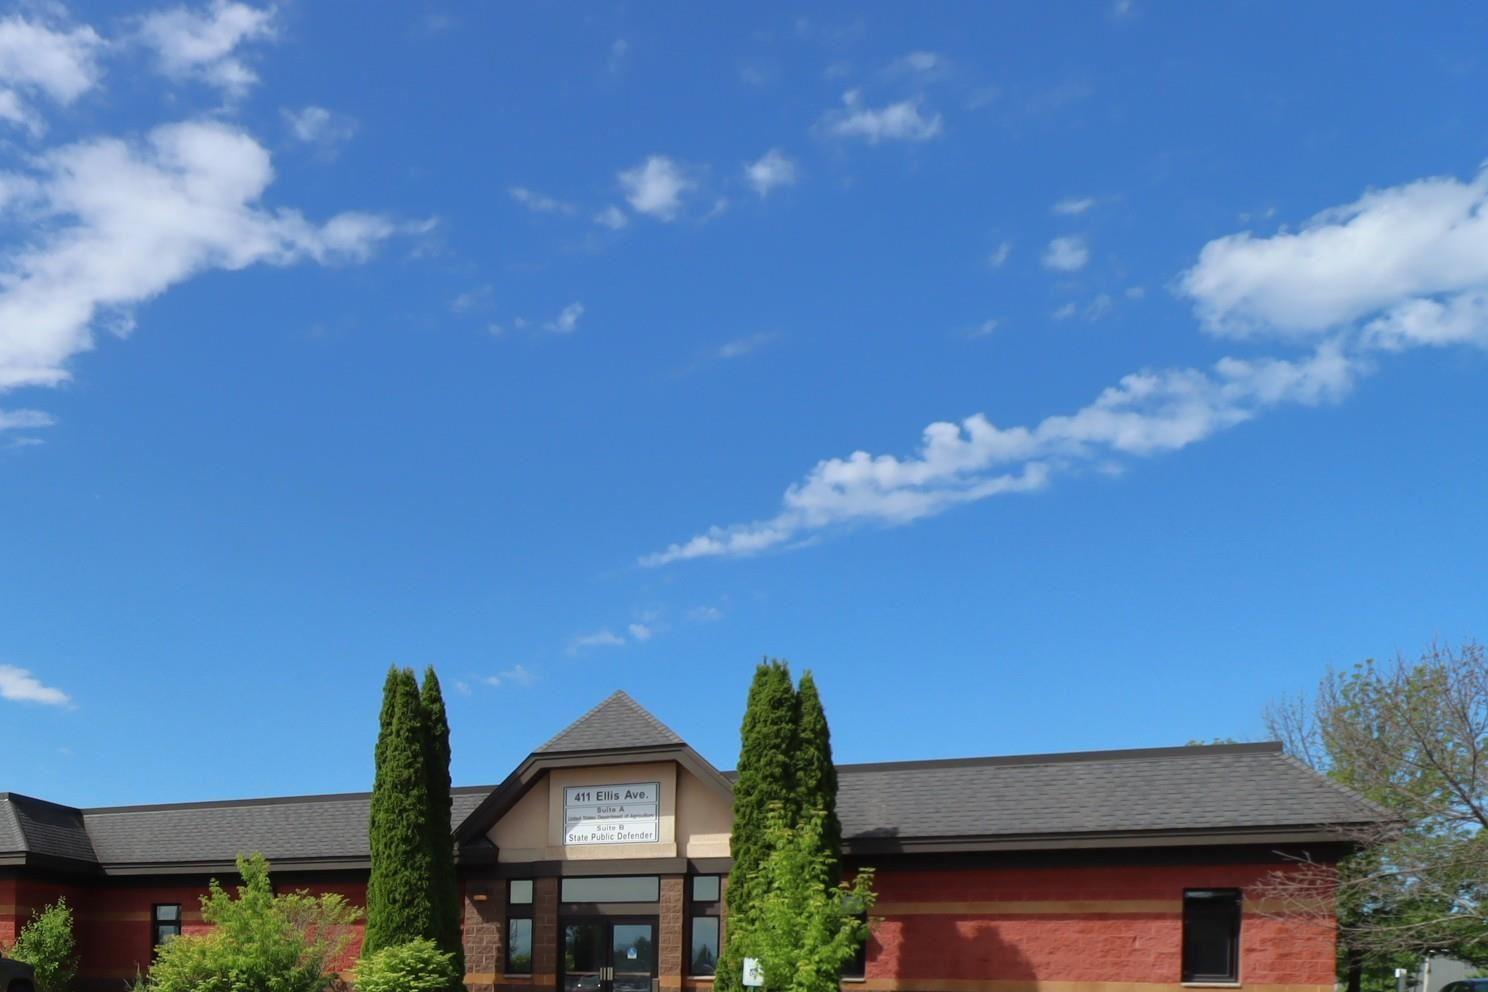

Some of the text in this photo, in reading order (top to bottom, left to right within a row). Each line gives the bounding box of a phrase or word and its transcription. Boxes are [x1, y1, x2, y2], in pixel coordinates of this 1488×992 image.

[574, 789, 649, 802] 411 Ellis Ave.
[597, 806, 616, 814] Suite
[569, 831, 653, 842] State Public Defender
